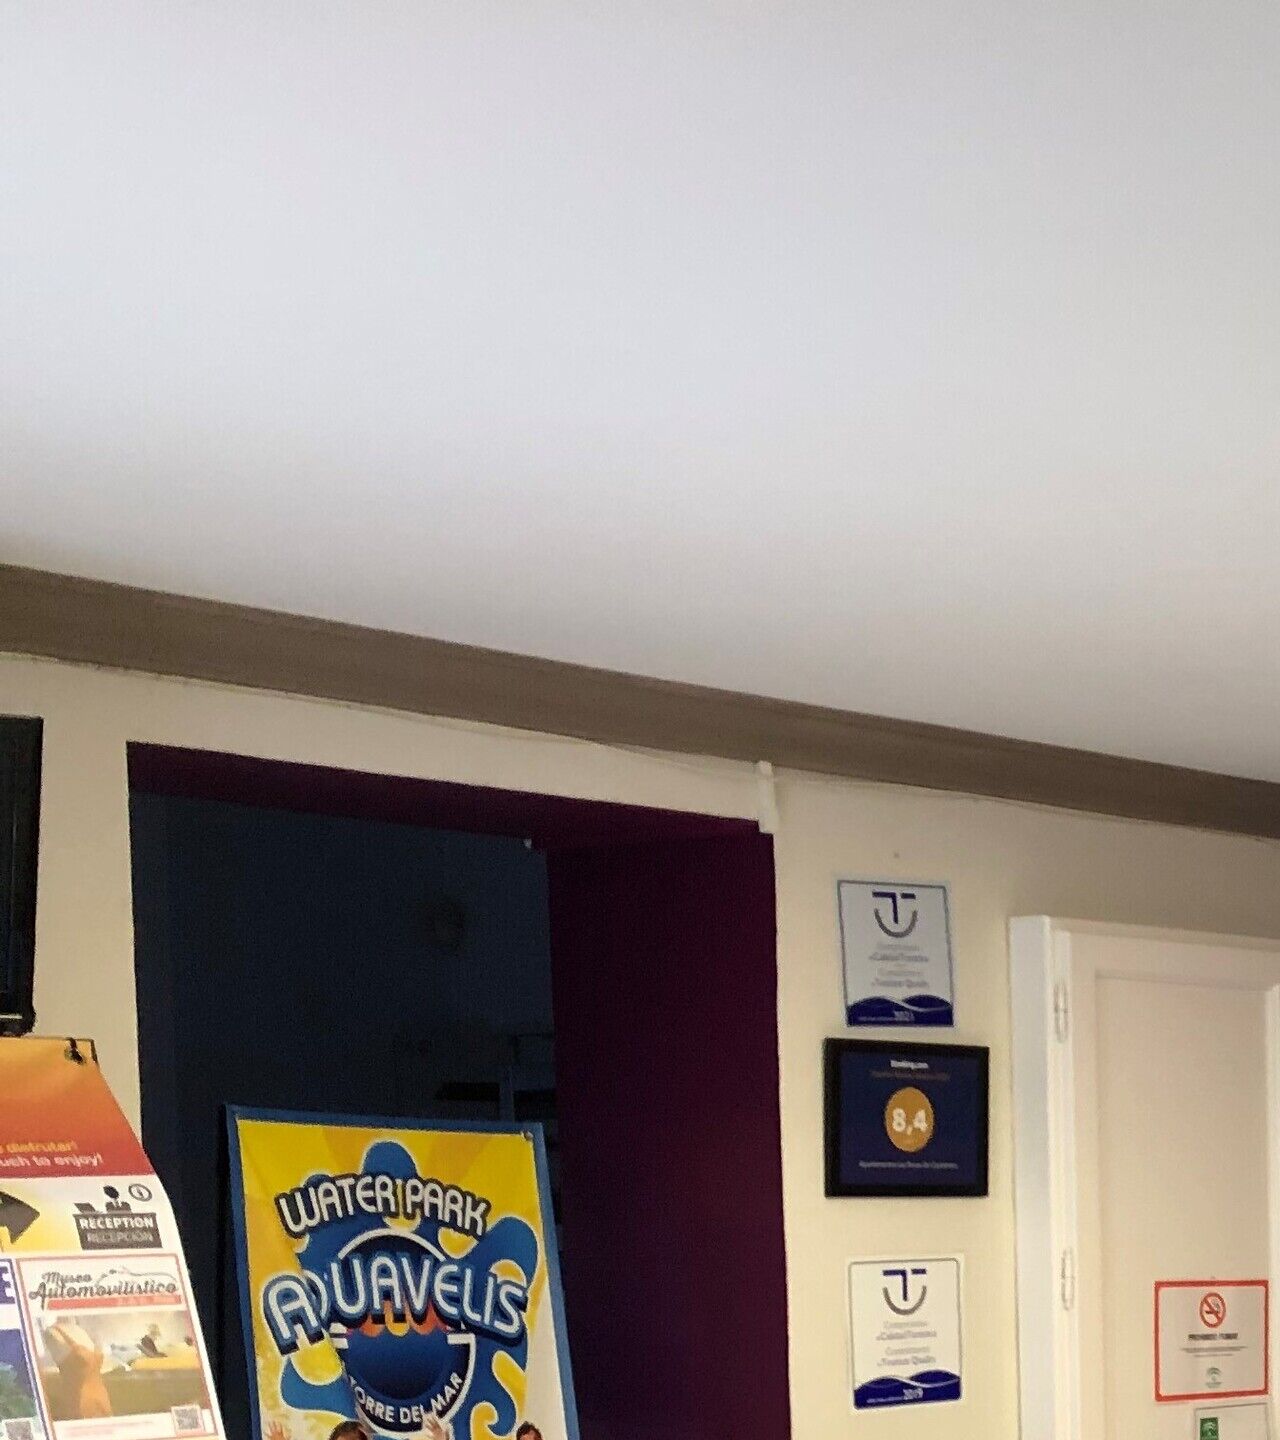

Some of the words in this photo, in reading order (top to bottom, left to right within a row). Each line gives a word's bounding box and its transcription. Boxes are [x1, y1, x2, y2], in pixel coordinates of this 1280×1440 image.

[53, 1152, 104, 1169] enjoy!
[279, 1174, 396, 1233] WATER
[404, 1177, 488, 1236] PARK
[79, 1217, 154, 1230] RECEPTION
[430, 1372, 464, 1412] MAR
